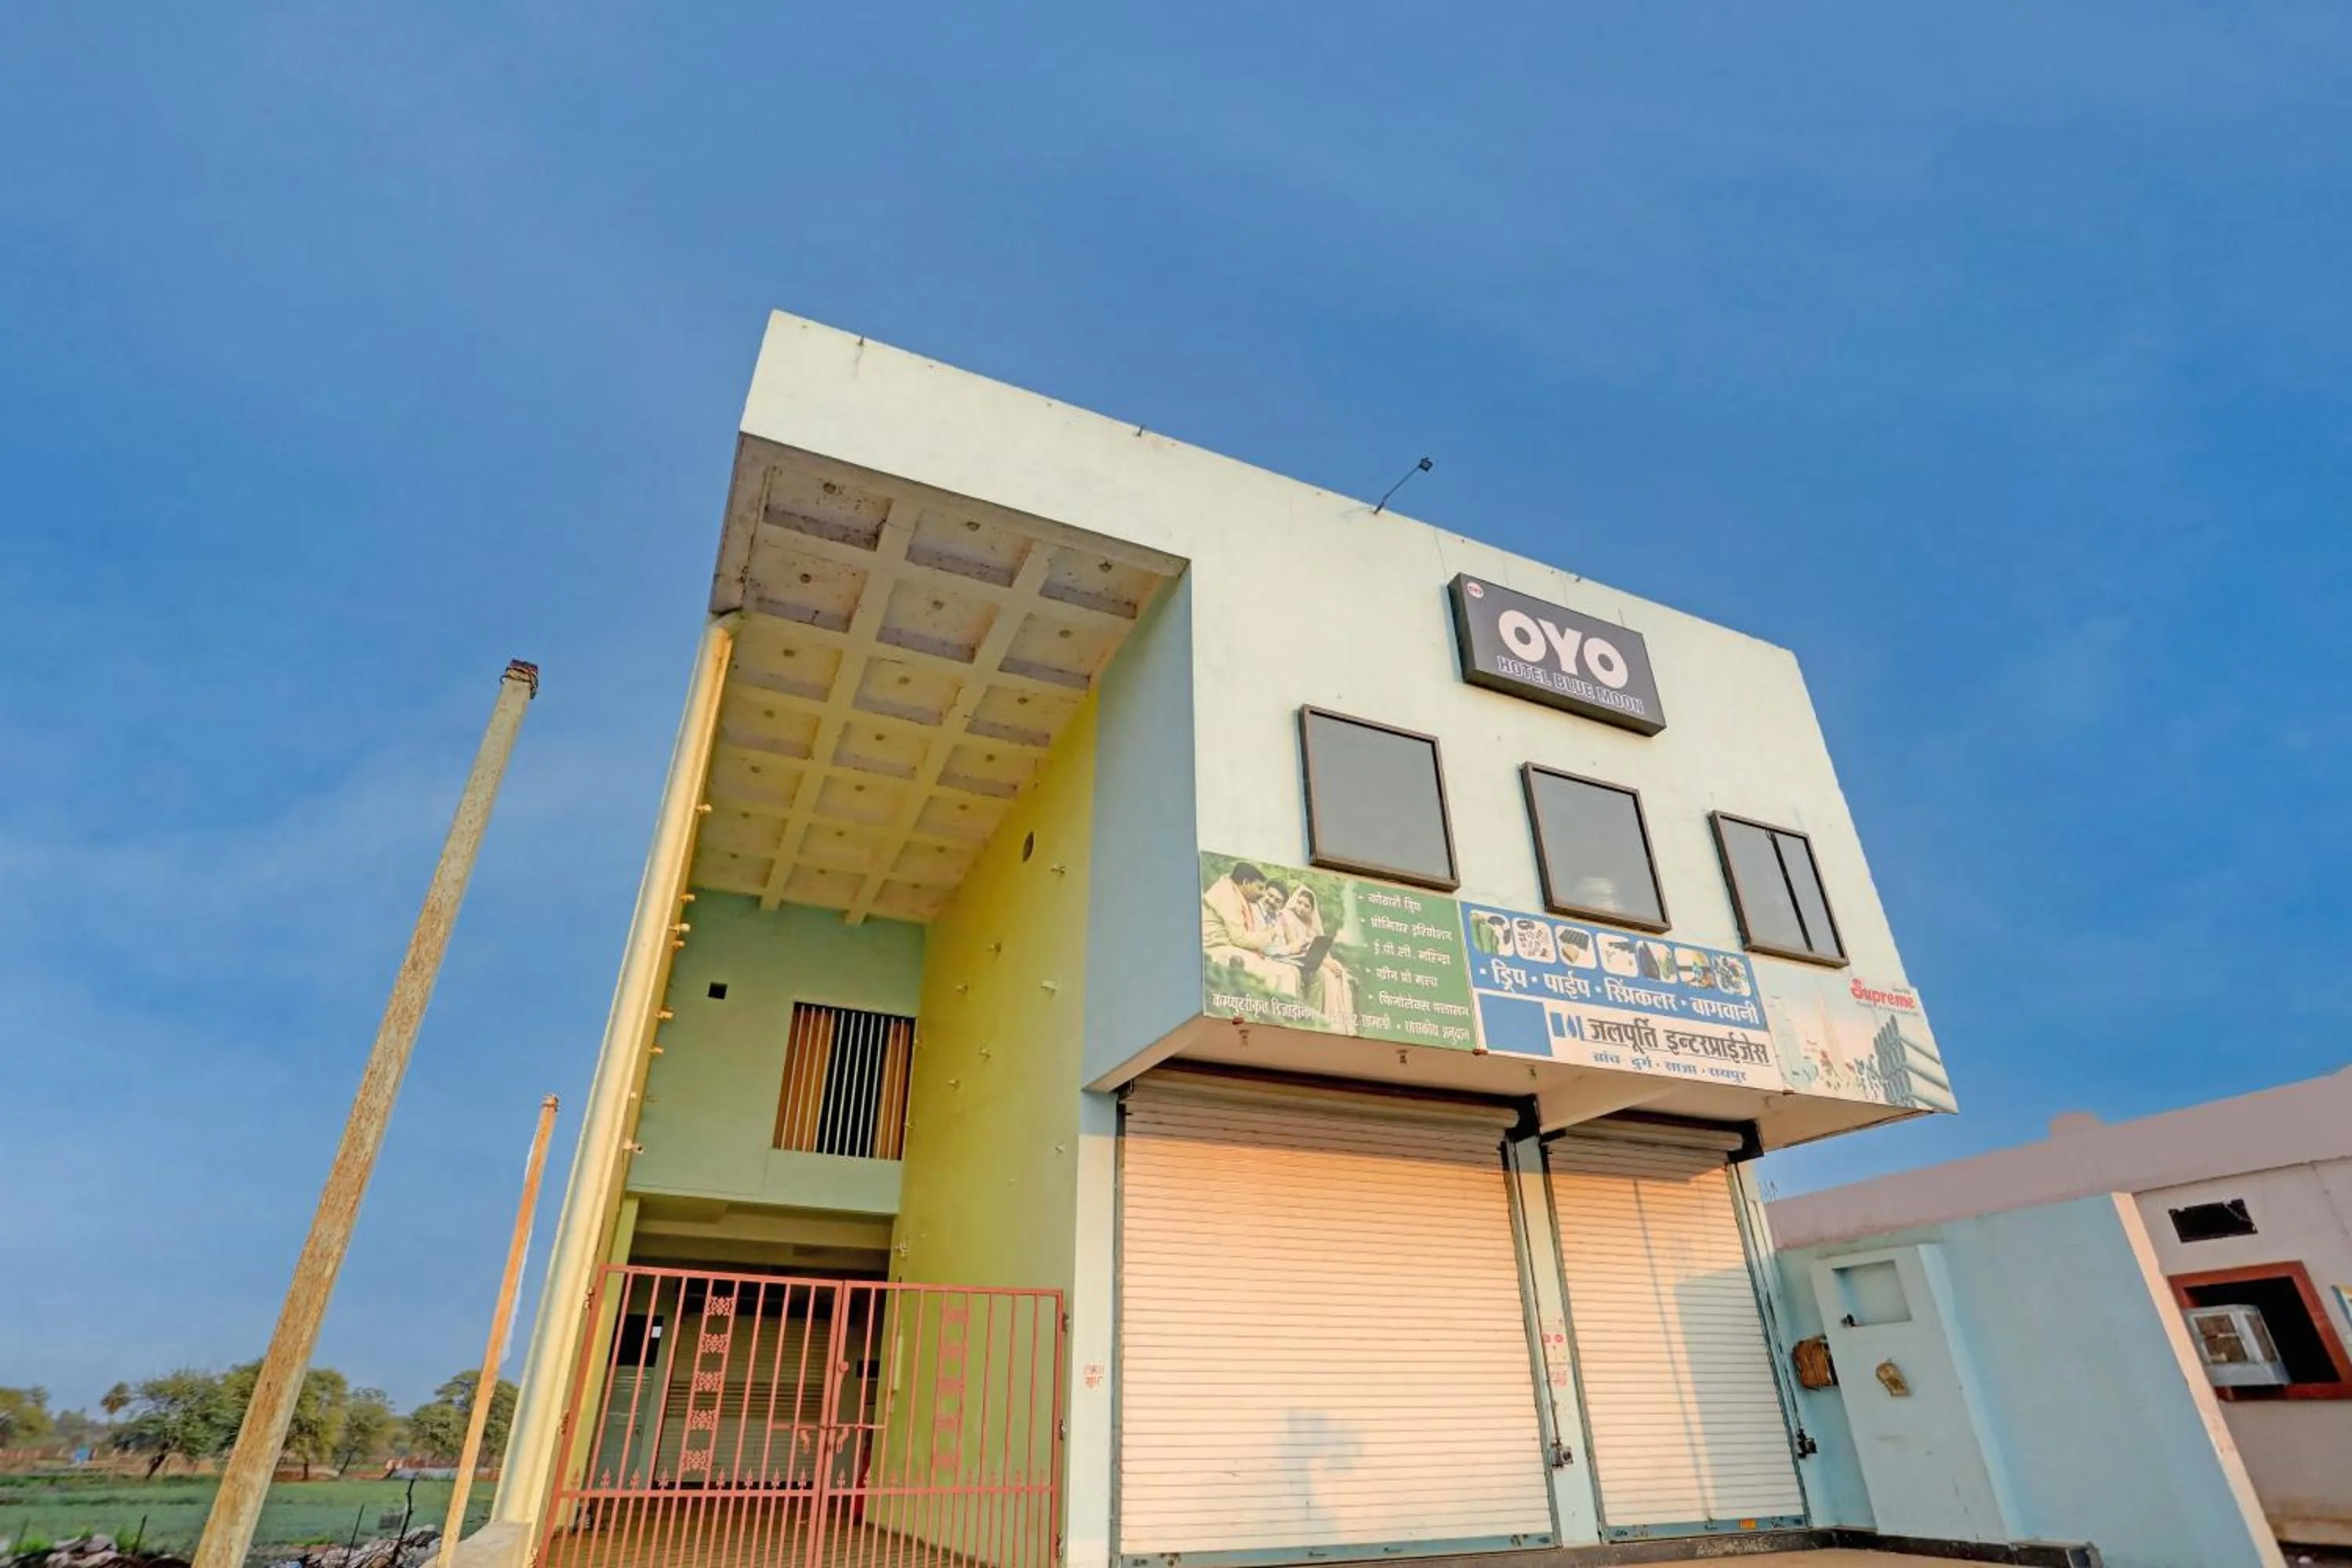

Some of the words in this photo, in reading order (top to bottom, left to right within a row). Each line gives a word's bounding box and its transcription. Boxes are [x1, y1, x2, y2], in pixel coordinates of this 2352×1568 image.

[1499, 610, 1628, 688] OYO
[1497, 655, 1552, 685] HOTEL
[1554, 673, 1595, 700] BLUE
[1595, 685, 1645, 714] MOON
[1491, 958, 1528, 993] ड्रिप
[1543, 970, 1591, 999] पाईप
[1689, 996, 1760, 1025] बागवानी
[1851, 978, 1916, 1008] Supreme
[1588, 1017, 1659, 1054] जलपूर्ति
